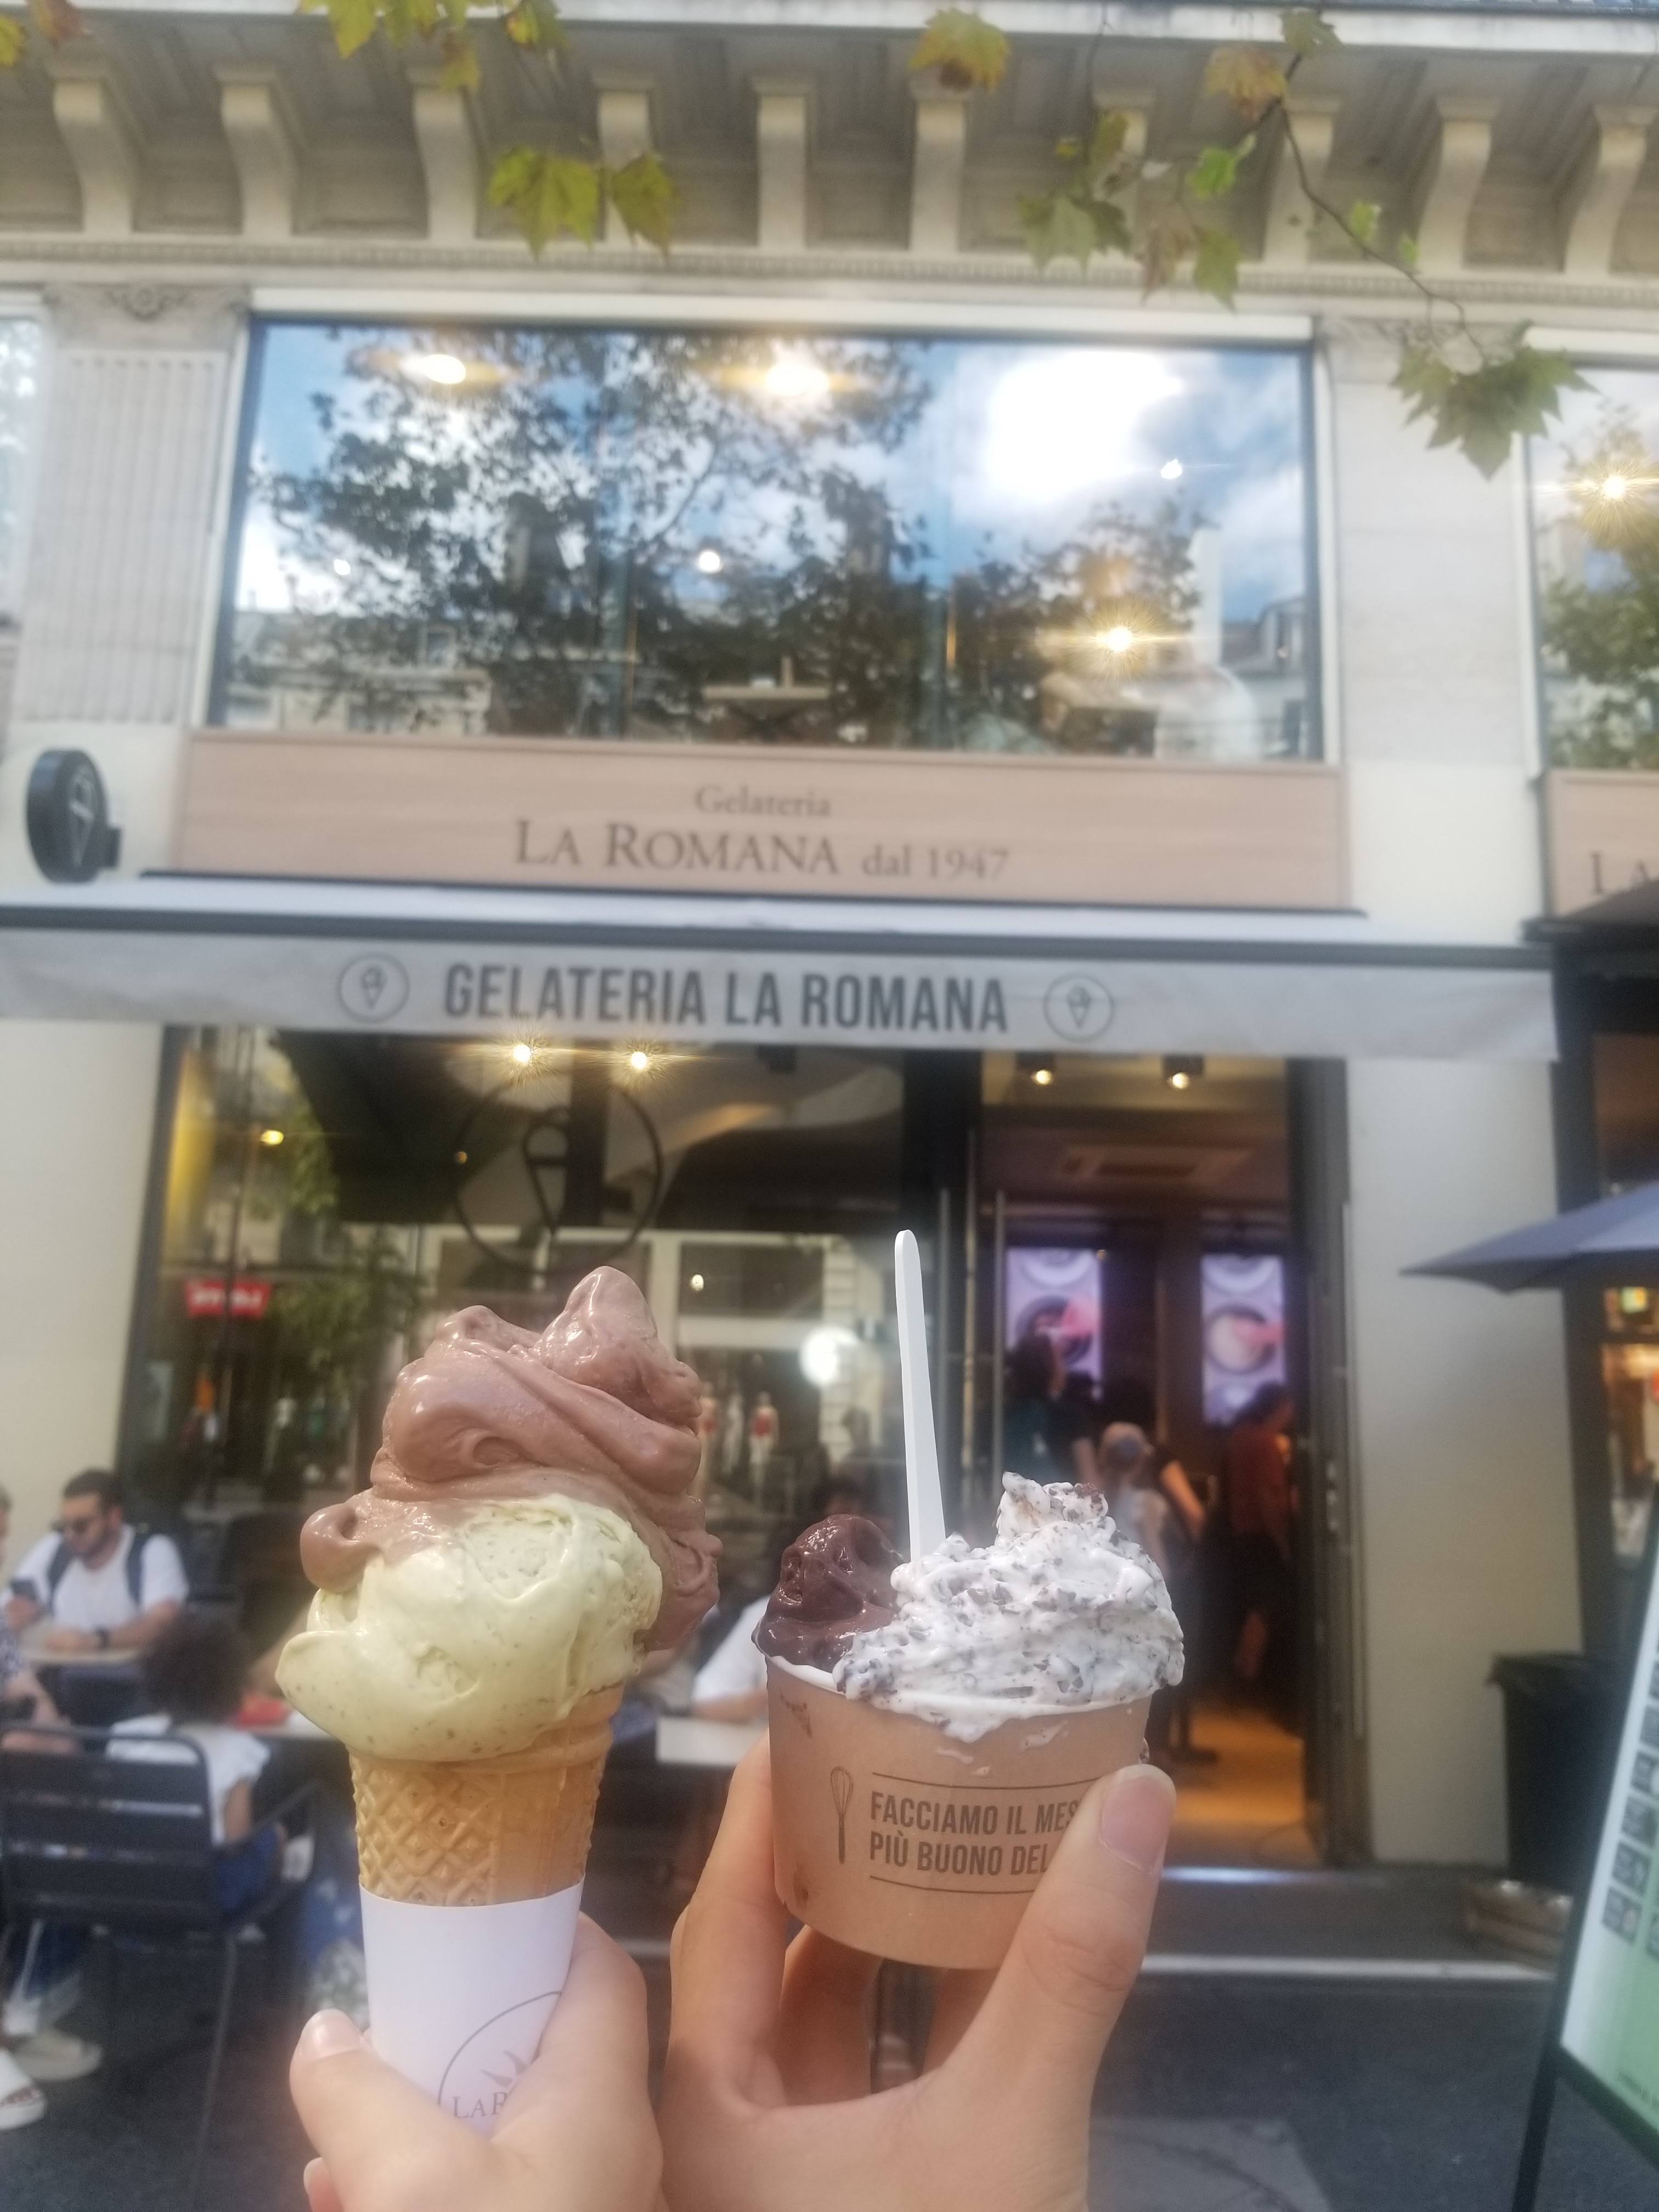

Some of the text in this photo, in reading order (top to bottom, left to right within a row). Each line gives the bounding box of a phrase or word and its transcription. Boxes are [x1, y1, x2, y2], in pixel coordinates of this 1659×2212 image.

[695, 786, 832, 819] Gelateria
[605, 822, 839, 875] ROMANA
[861, 844, 911, 875] dal
[926, 847, 1011, 878] 1947
[445, 963, 1008, 1031] GELATERIA LA ROMANA
[871, 1791, 1080, 1835] FACCIAMO IL MES
[871, 1829, 908, 1866] PIÙ
[918, 1842, 1003, 1876] BUONO
